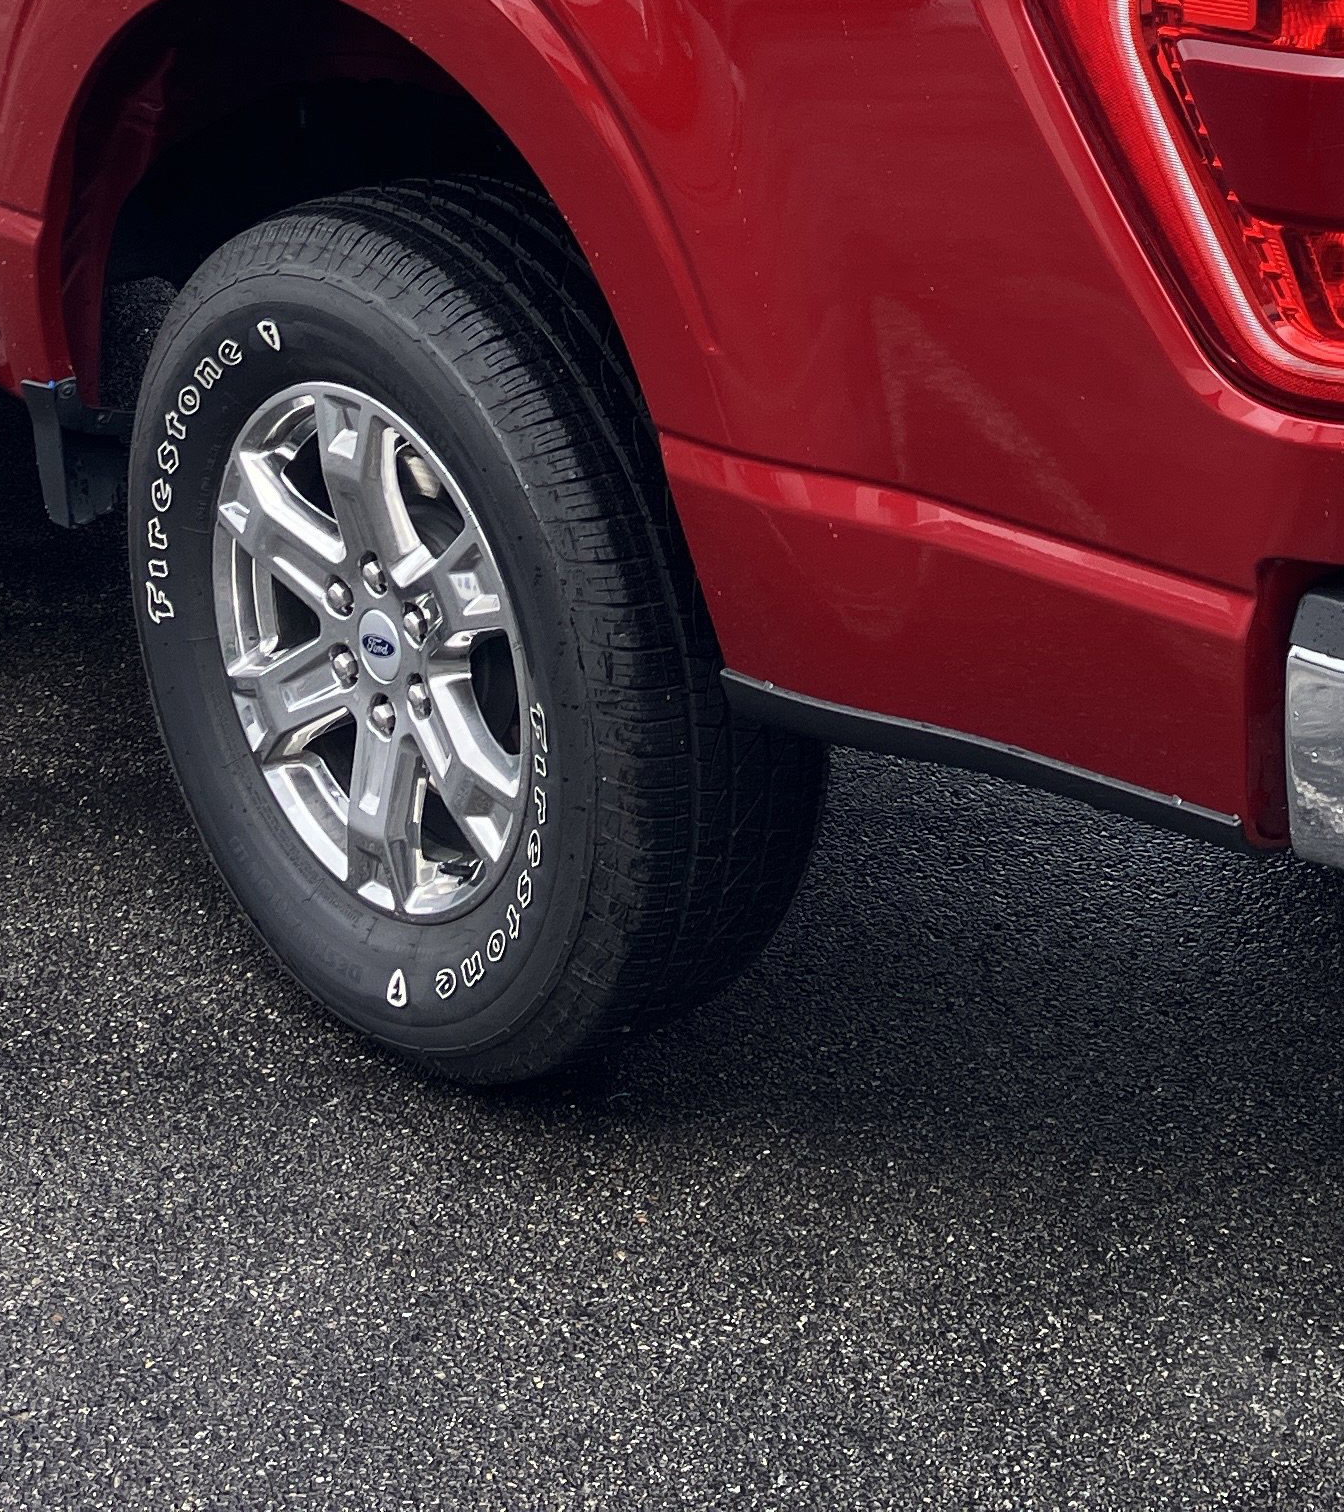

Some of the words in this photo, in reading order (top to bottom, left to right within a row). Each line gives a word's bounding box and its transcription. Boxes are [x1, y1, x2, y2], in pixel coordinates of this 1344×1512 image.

[146, 339, 243, 625] Firestone
[366, 636, 389, 656] Ford
[435, 702, 548, 1000] Firestone
